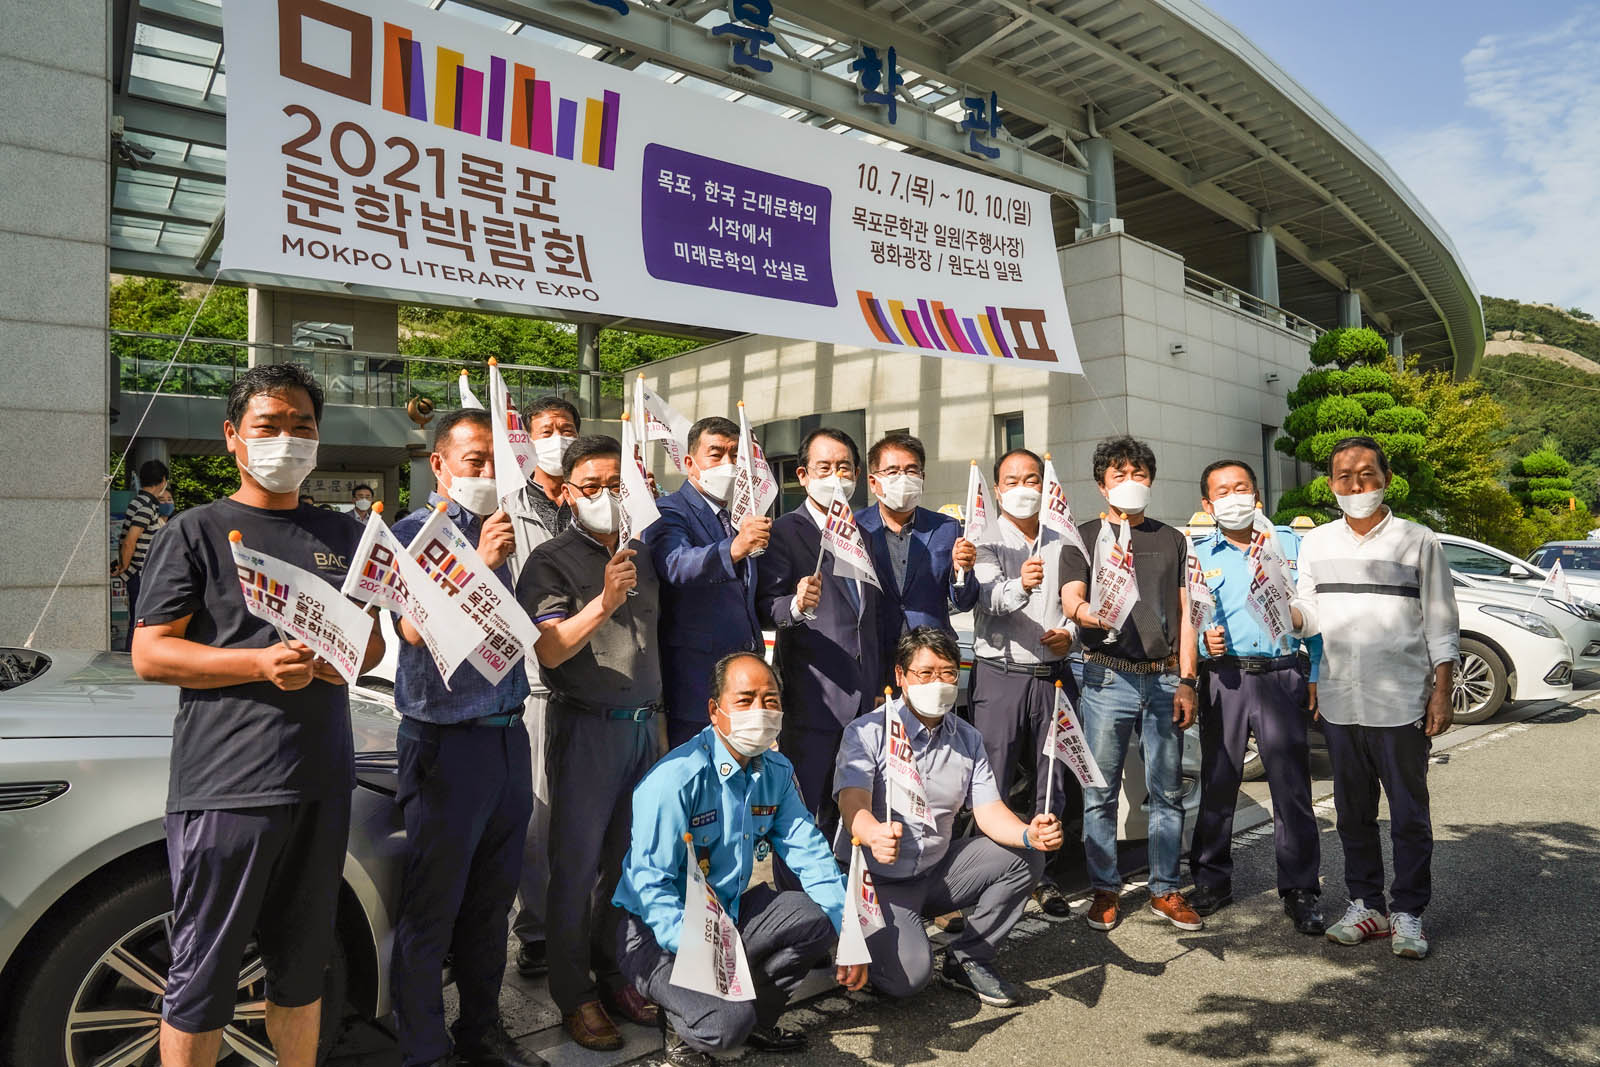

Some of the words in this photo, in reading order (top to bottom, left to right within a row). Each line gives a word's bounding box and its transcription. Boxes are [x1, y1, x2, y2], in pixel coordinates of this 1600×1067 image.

[657, 168, 697, 202] 목포,
[704, 179, 736, 208] 한국
[742, 188, 817, 226] 근대문학의
[282, 163, 593, 283] 문학박람회
[708, 215, 773, 248] 시작에서
[851, 206, 929, 245] 목포문학관
[934, 221, 1025, 260] 일원(주행사장)
[282, 234, 392, 270] MOKPO
[401, 257, 526, 292] LITERARY
[536, 281, 600, 302] EXPO
[674, 241, 757, 276] 미래문학의
[762, 257, 808, 283] 산실로
[869, 239, 933, 274] 평화광장
[948, 253, 990, 279] 원도심
[993, 257, 1024, 283] 일원
[296, 601, 324, 625] 목포
[297, 592, 325, 612] 2021
[467, 590, 495, 618] 목포
[477, 582, 502, 607] 2021
[293, 613, 358, 666] 문학박람회
